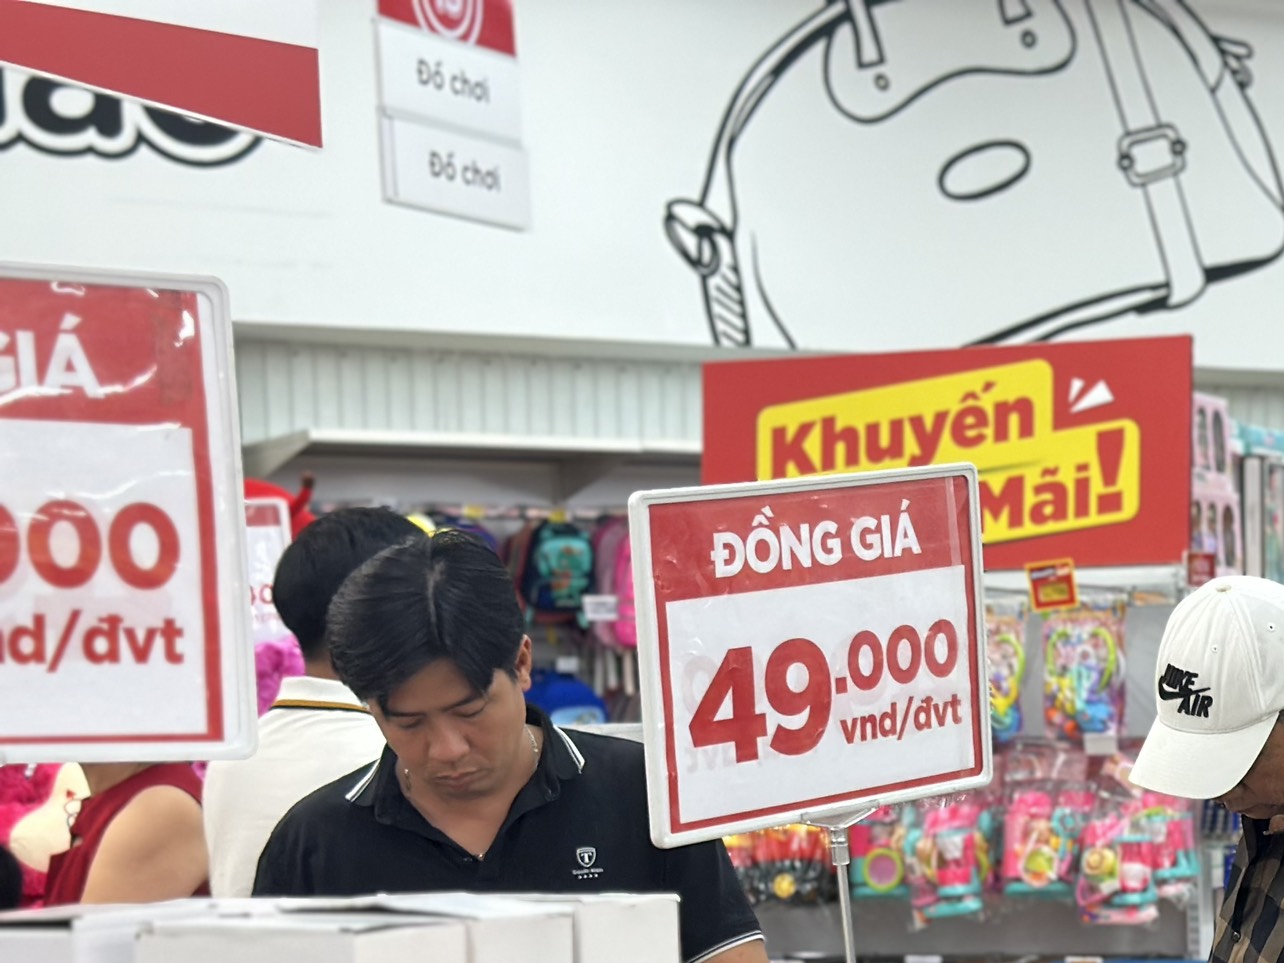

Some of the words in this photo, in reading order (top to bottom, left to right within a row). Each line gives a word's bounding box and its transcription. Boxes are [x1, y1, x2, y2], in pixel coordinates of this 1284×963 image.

[771, 381, 1035, 480] Khuyến
[981, 427, 1125, 531] Mãi!
[711, 505, 843, 579] ĐỒNG
[850, 498, 922, 561] GIÁ
[839, 693, 963, 746] vnd/đvt
[1177, 694, 1213, 718] AIR
